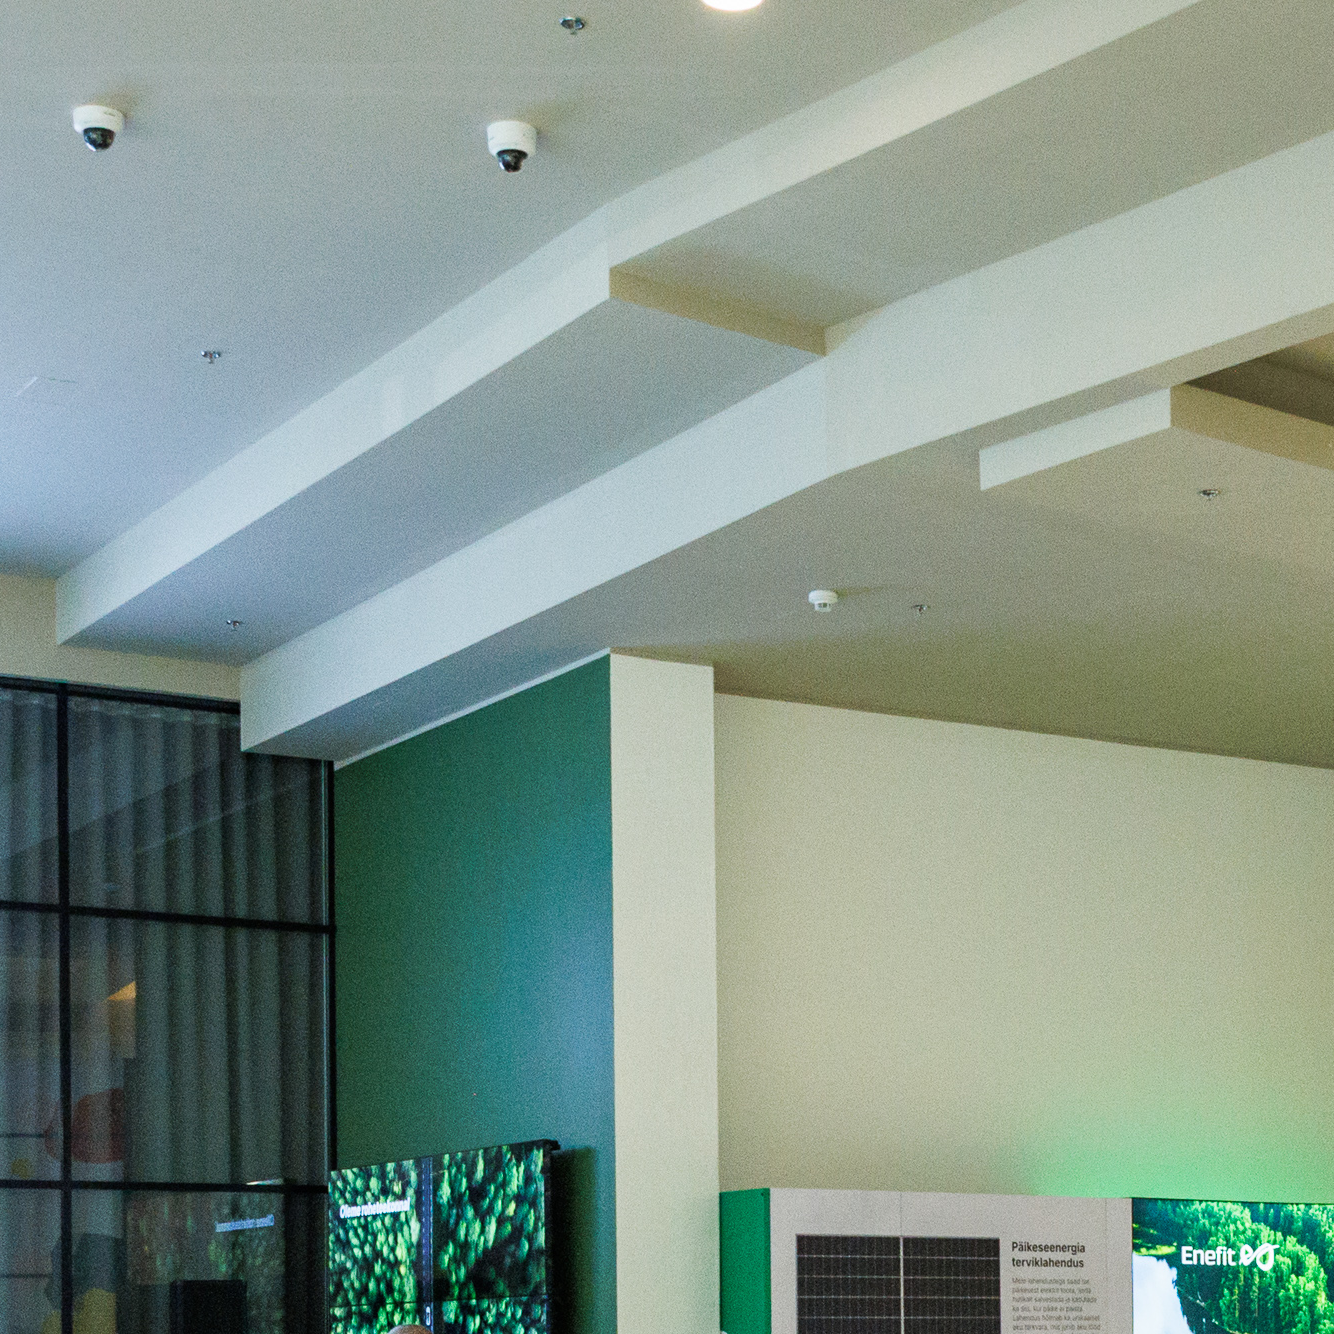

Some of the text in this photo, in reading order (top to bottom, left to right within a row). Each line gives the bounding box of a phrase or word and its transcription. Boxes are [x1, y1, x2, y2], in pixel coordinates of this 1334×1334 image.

[1011, 1242, 1086, 1256] Päikeseenergia
[1181, 1245, 1237, 1267] Enefit
[1011, 1257, 1085, 1269] terviklahendus
